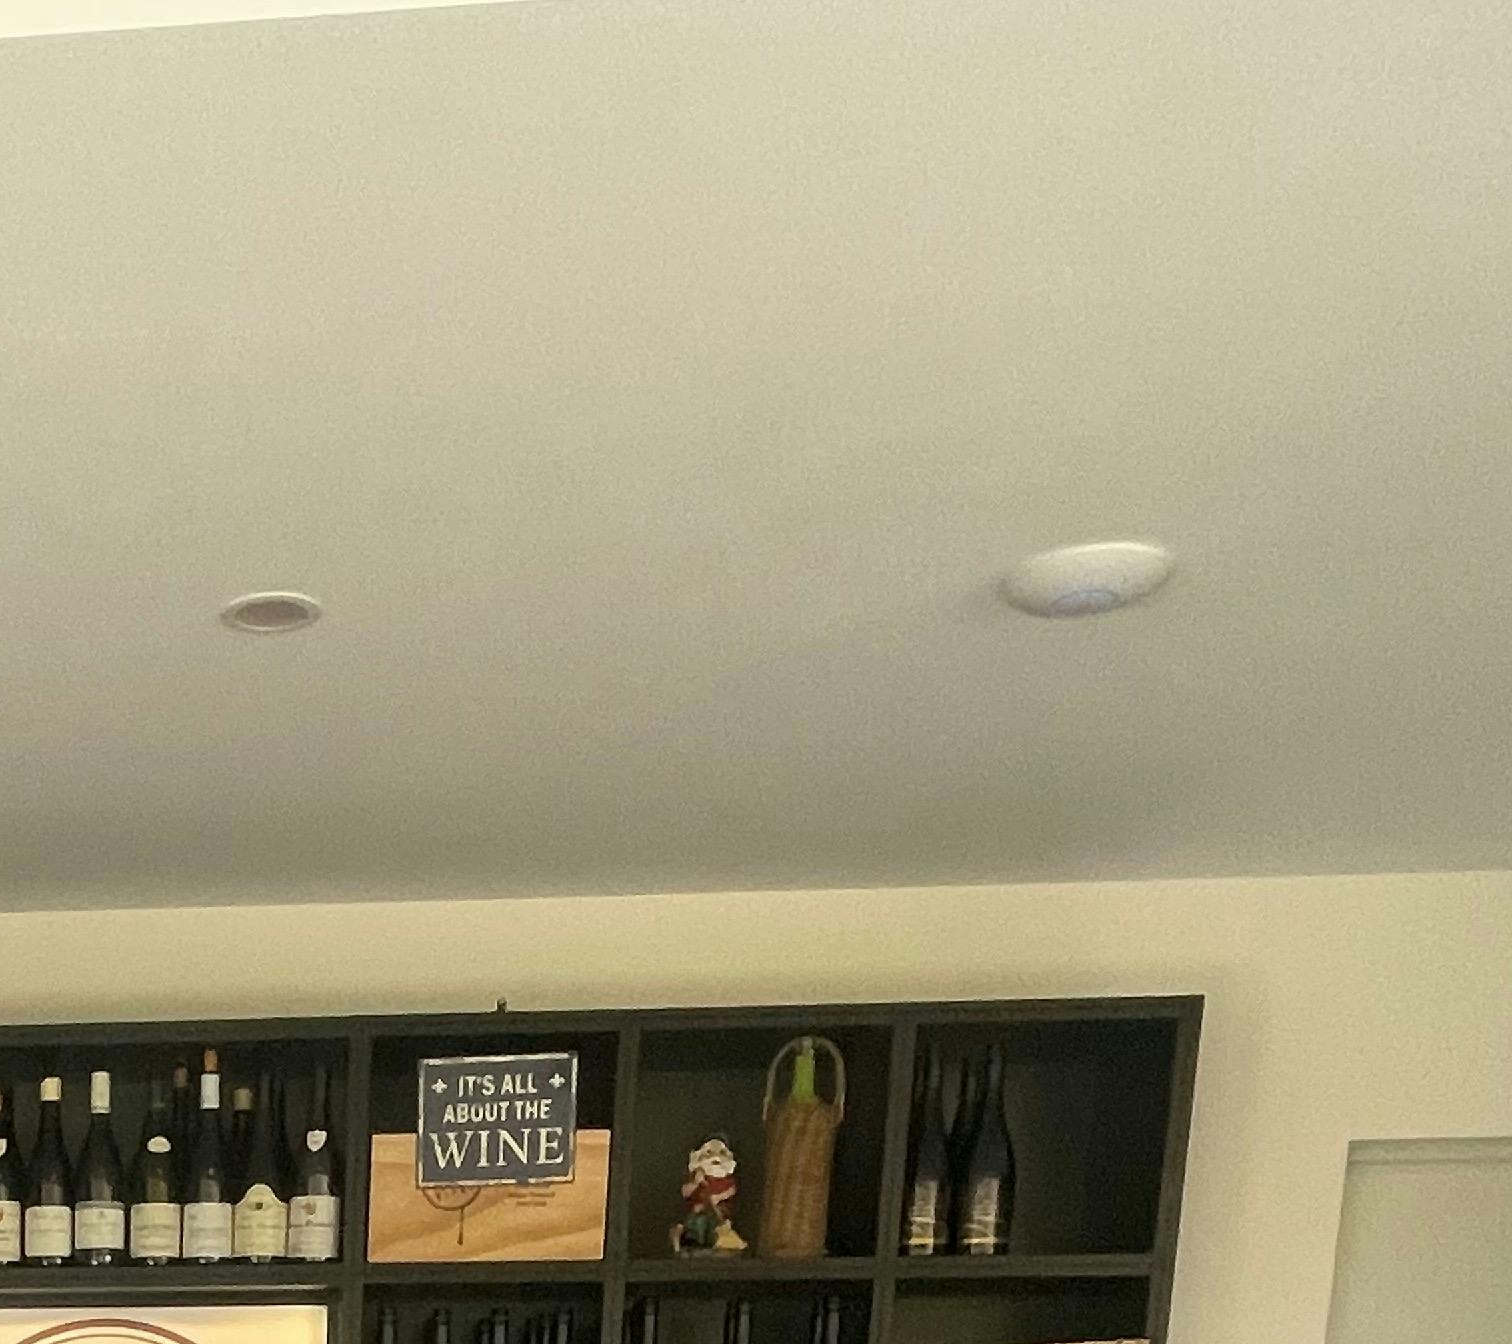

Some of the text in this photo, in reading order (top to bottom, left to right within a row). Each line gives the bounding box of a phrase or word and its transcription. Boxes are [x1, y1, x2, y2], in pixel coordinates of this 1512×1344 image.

[458, 1072, 538, 1098] IT'S ALL
[442, 1098, 553, 1124] ABOUT THE
[428, 1126, 564, 1169] WINE
